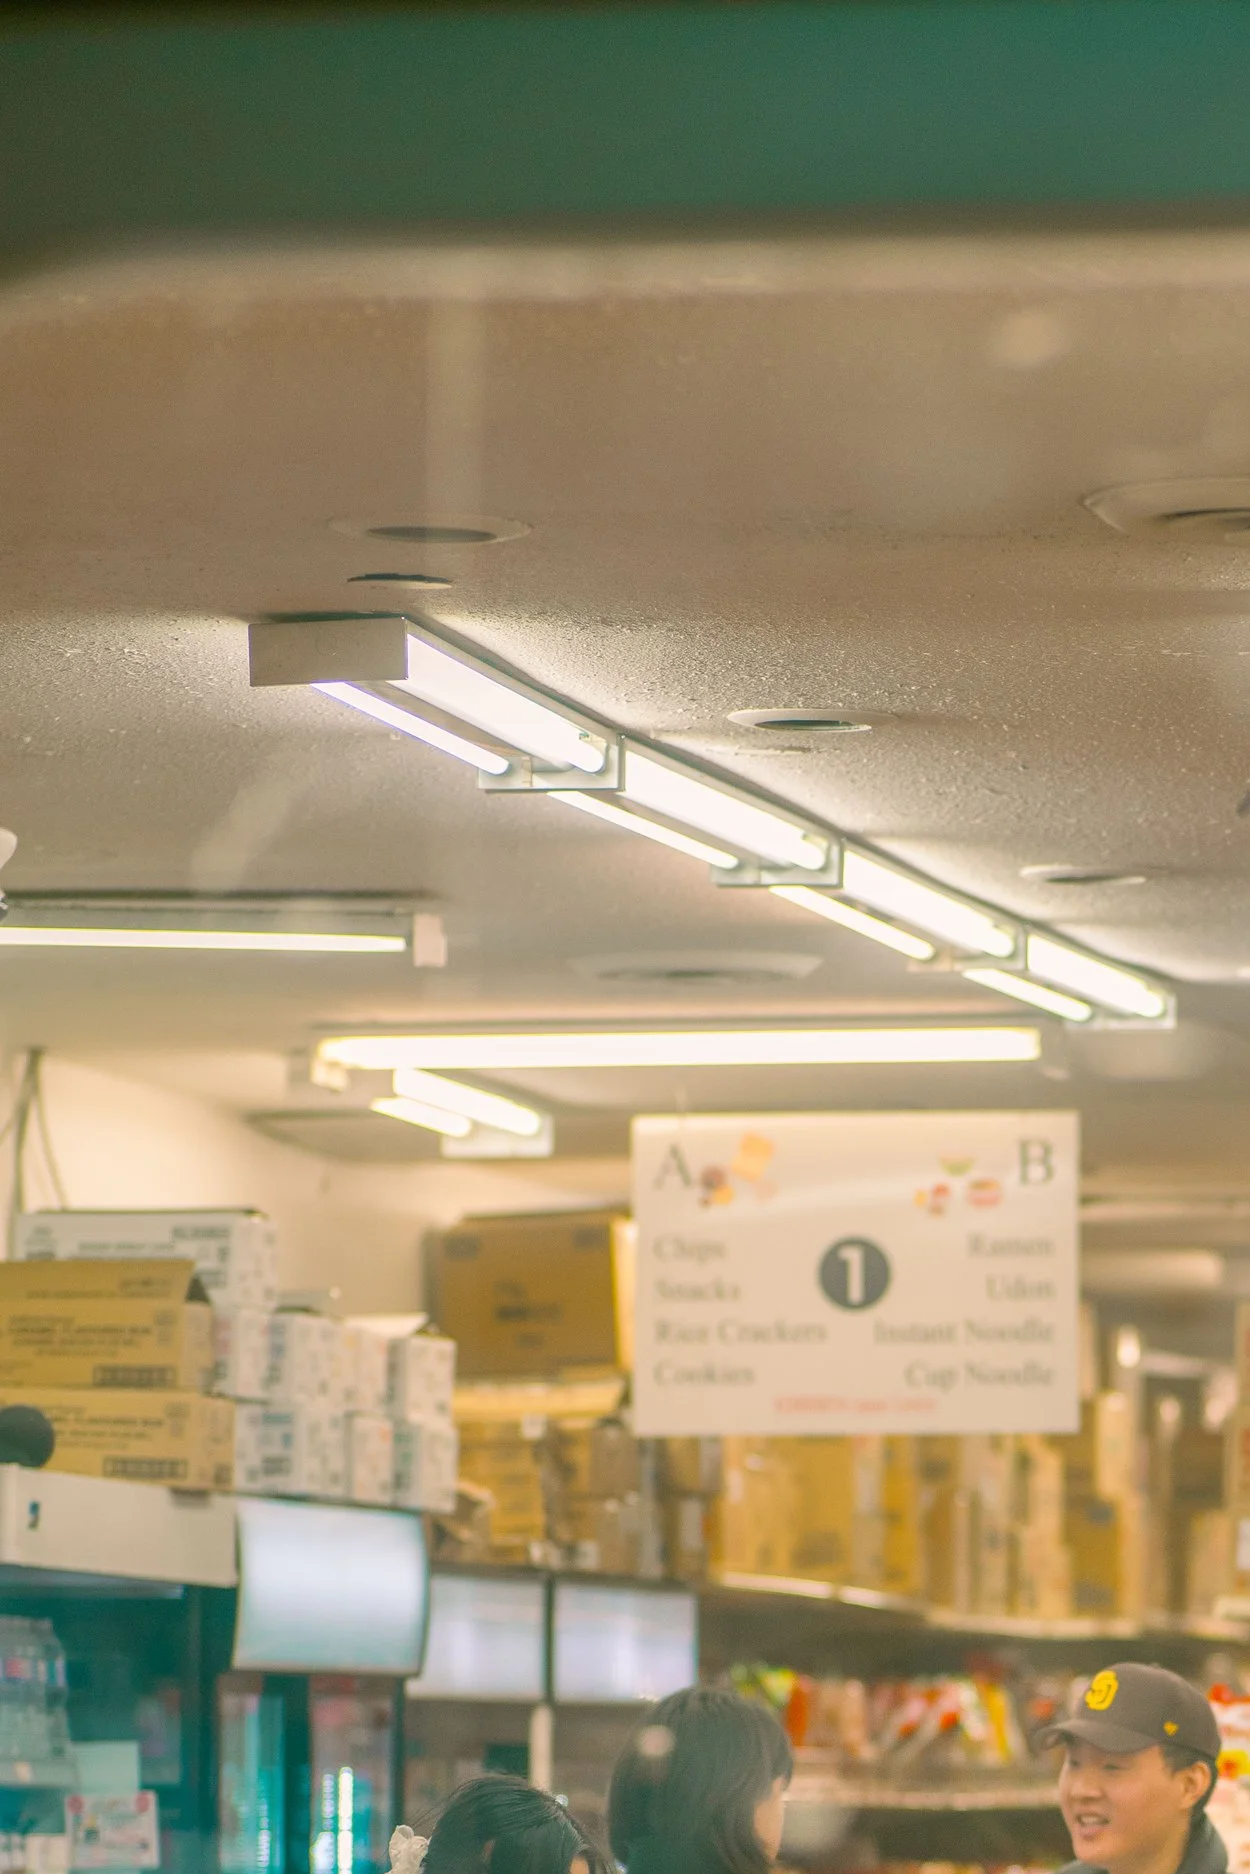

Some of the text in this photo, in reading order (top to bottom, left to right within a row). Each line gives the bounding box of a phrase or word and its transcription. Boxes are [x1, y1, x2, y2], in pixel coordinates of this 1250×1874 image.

[653, 1143, 693, 1189] A
[1018, 1139, 1054, 1185] B
[653, 1236, 725, 1264] Chips
[967, 1235, 1053, 1257] Ramen
[653, 1277, 740, 1302] Snacks
[986, 1277, 1053, 1299] Udon
[655, 1320, 828, 1344] Rice Crackers
[874, 1320, 1054, 1344] Instant Noodle
[655, 1362, 755, 1387] Cookies
[904, 1363, 1054, 1391] Cup Noodle
